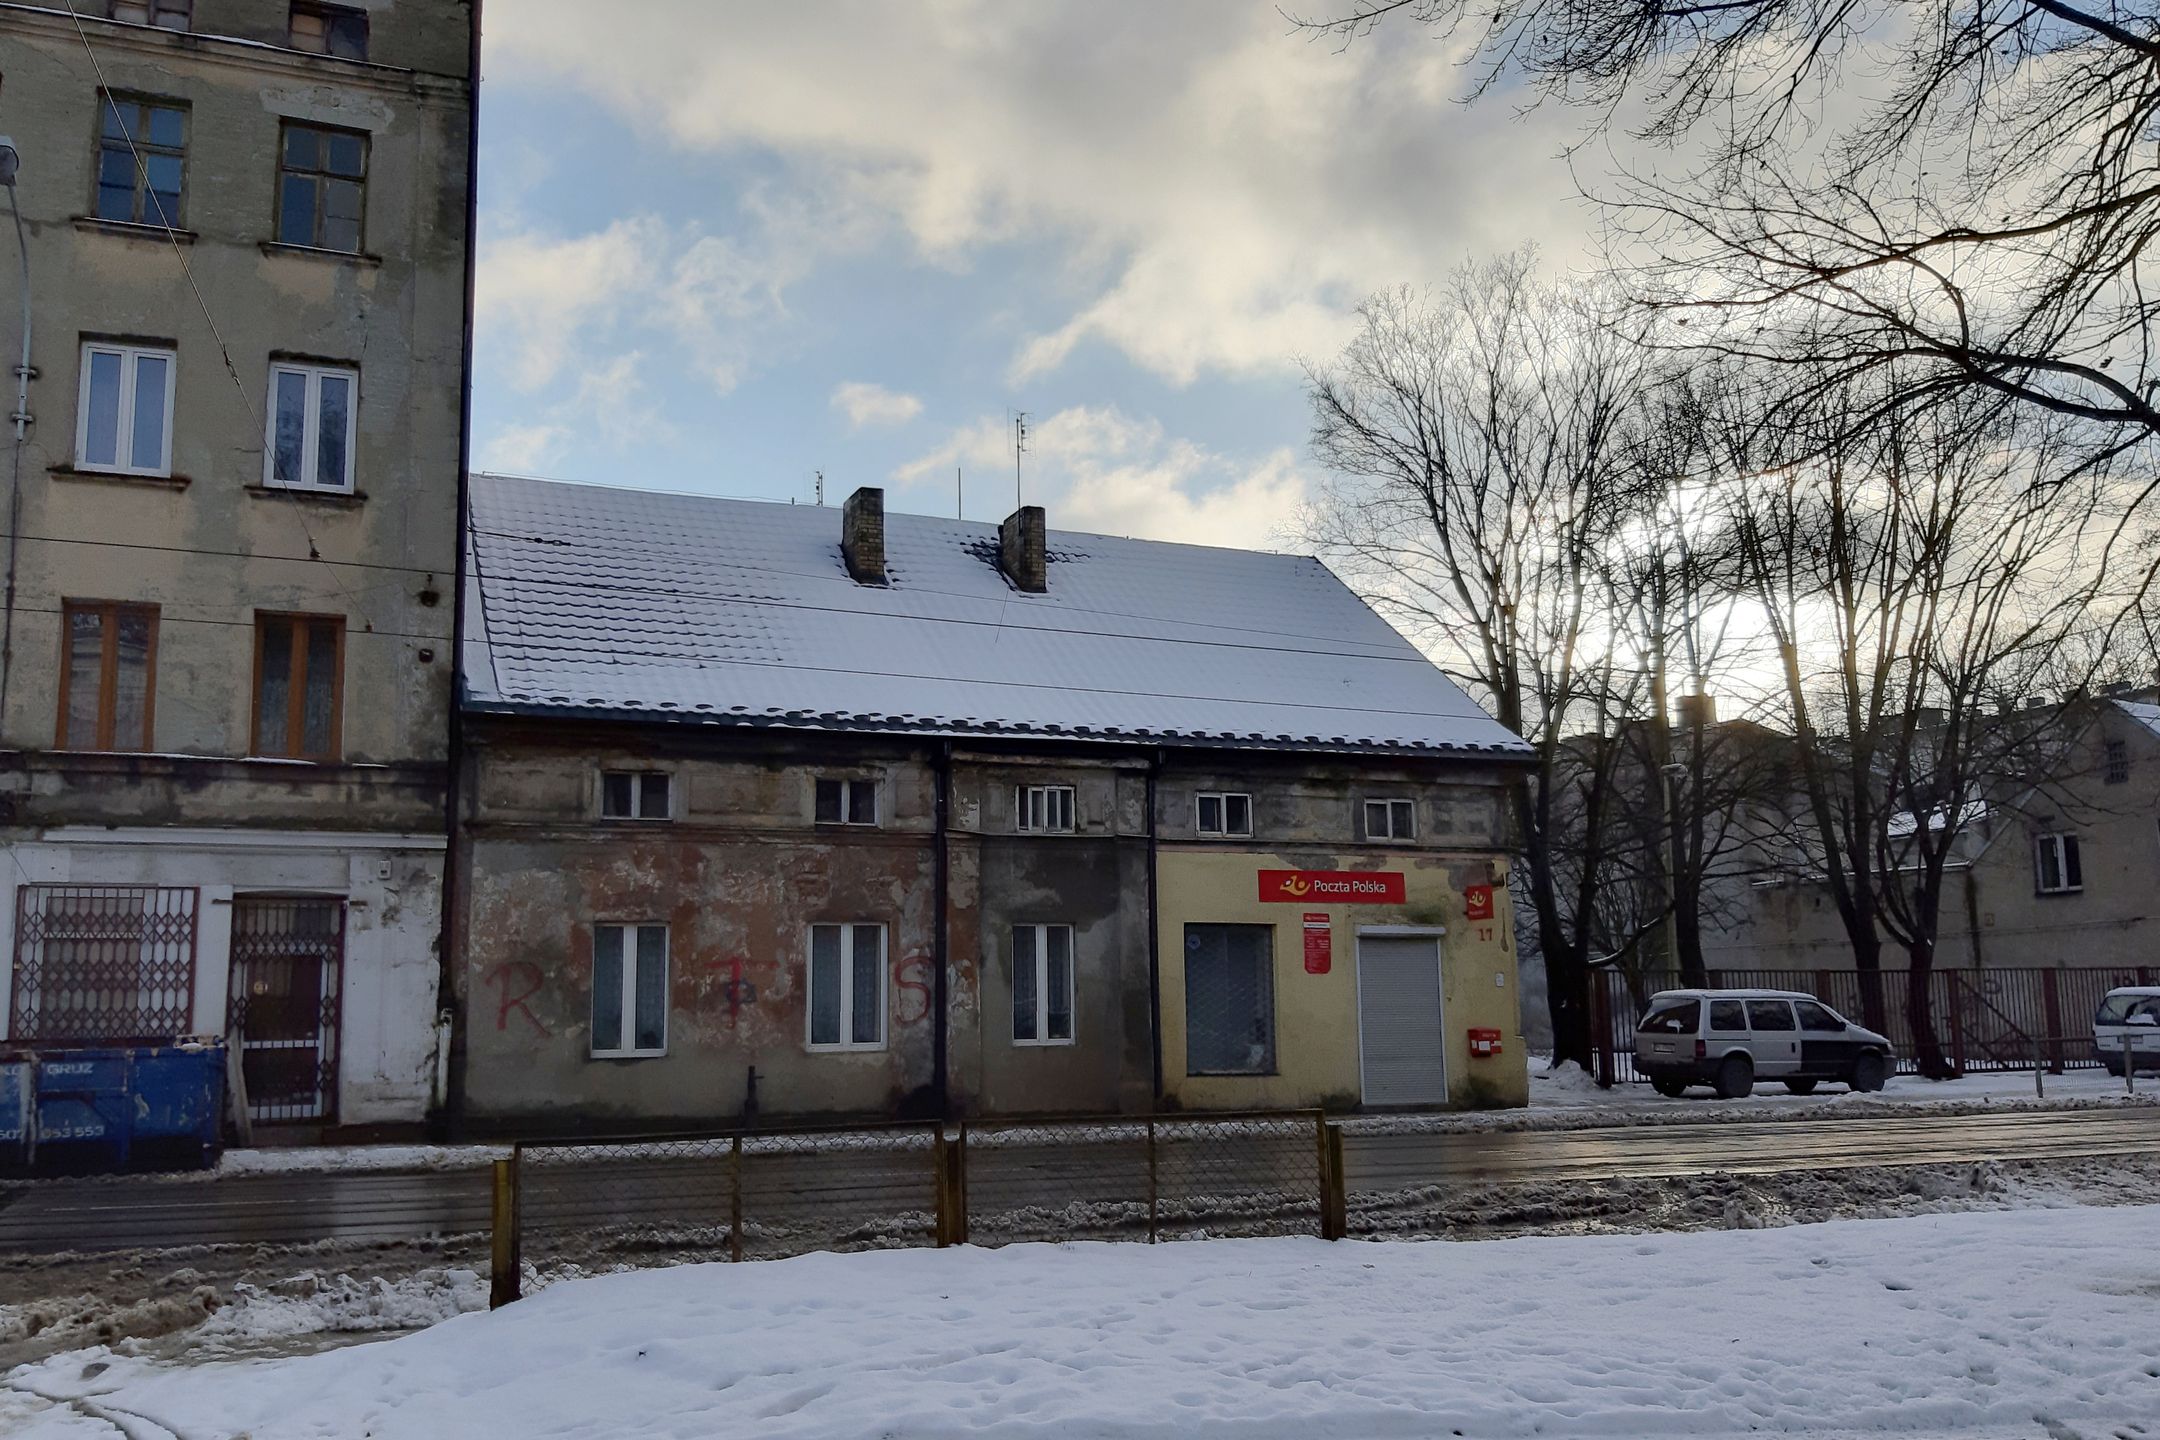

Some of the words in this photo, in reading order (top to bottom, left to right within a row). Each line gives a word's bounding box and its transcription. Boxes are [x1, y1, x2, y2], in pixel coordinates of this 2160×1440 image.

[1314, 879, 1350, 893] Poczta
[1352, 880, 1386, 893] Polska
[1478, 927, 1493, 942] 17
[47, 1062, 95, 1075] GRUZ
